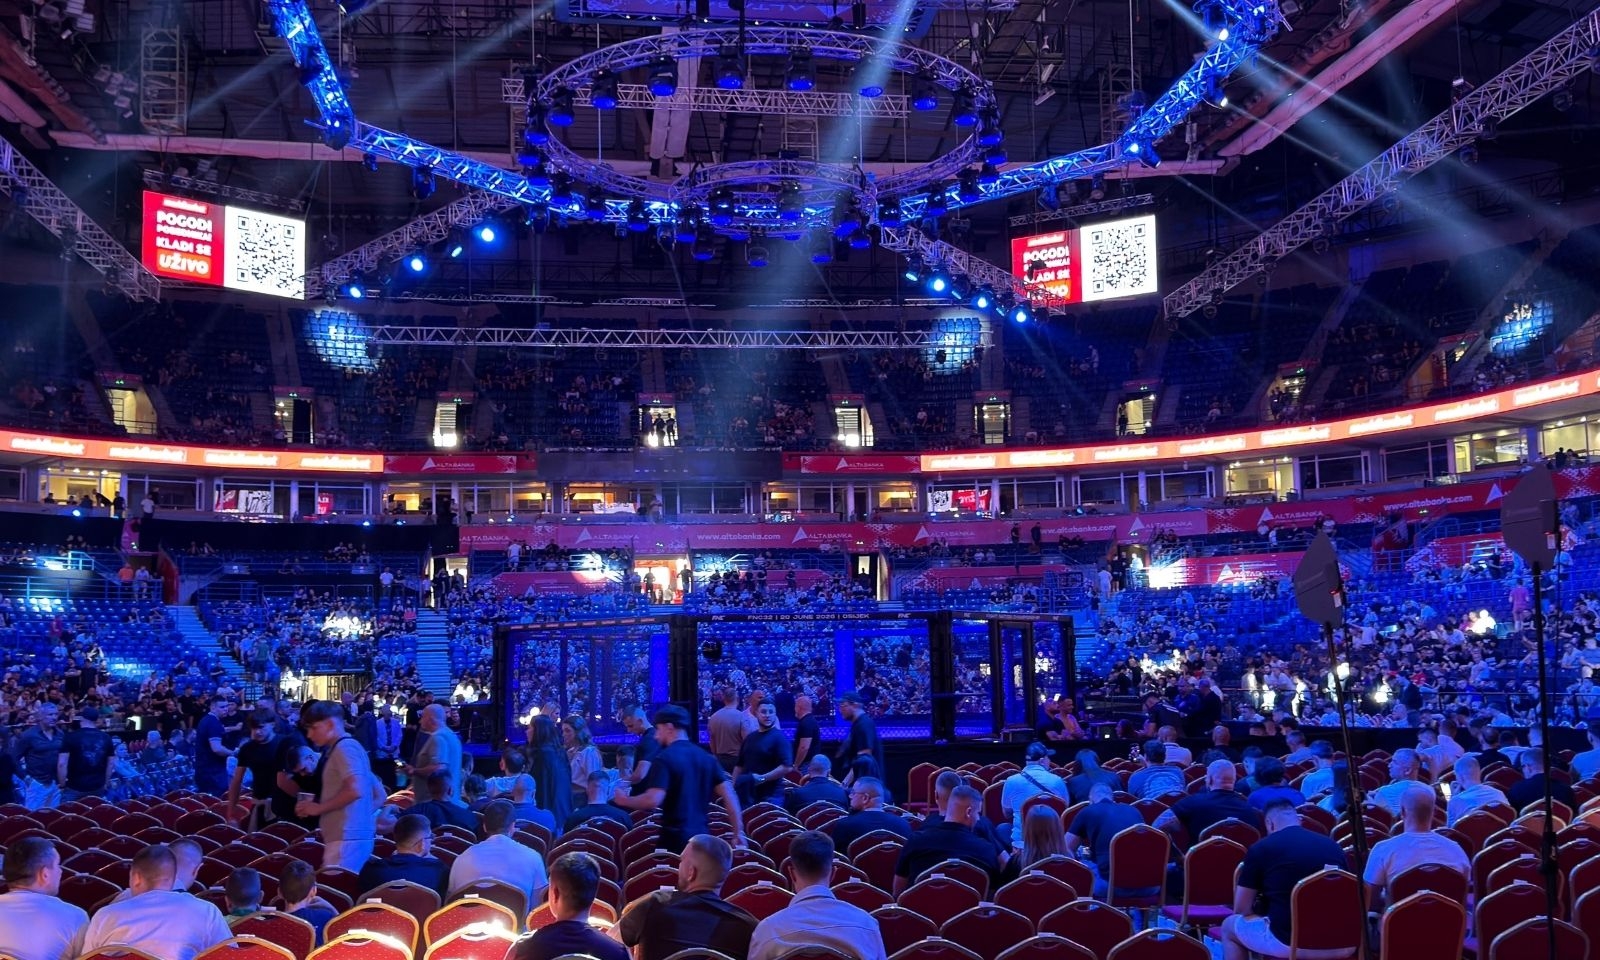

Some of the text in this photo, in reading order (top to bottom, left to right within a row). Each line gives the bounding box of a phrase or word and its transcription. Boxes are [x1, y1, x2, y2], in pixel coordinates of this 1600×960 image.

[157, 210, 213, 233] POGODI
[156, 236, 194, 254] KLADI
[1023, 245, 1070, 264] POGODI
[159, 252, 209, 275] UŽIVO
[696, 532, 781, 540] www.altabanka.com
